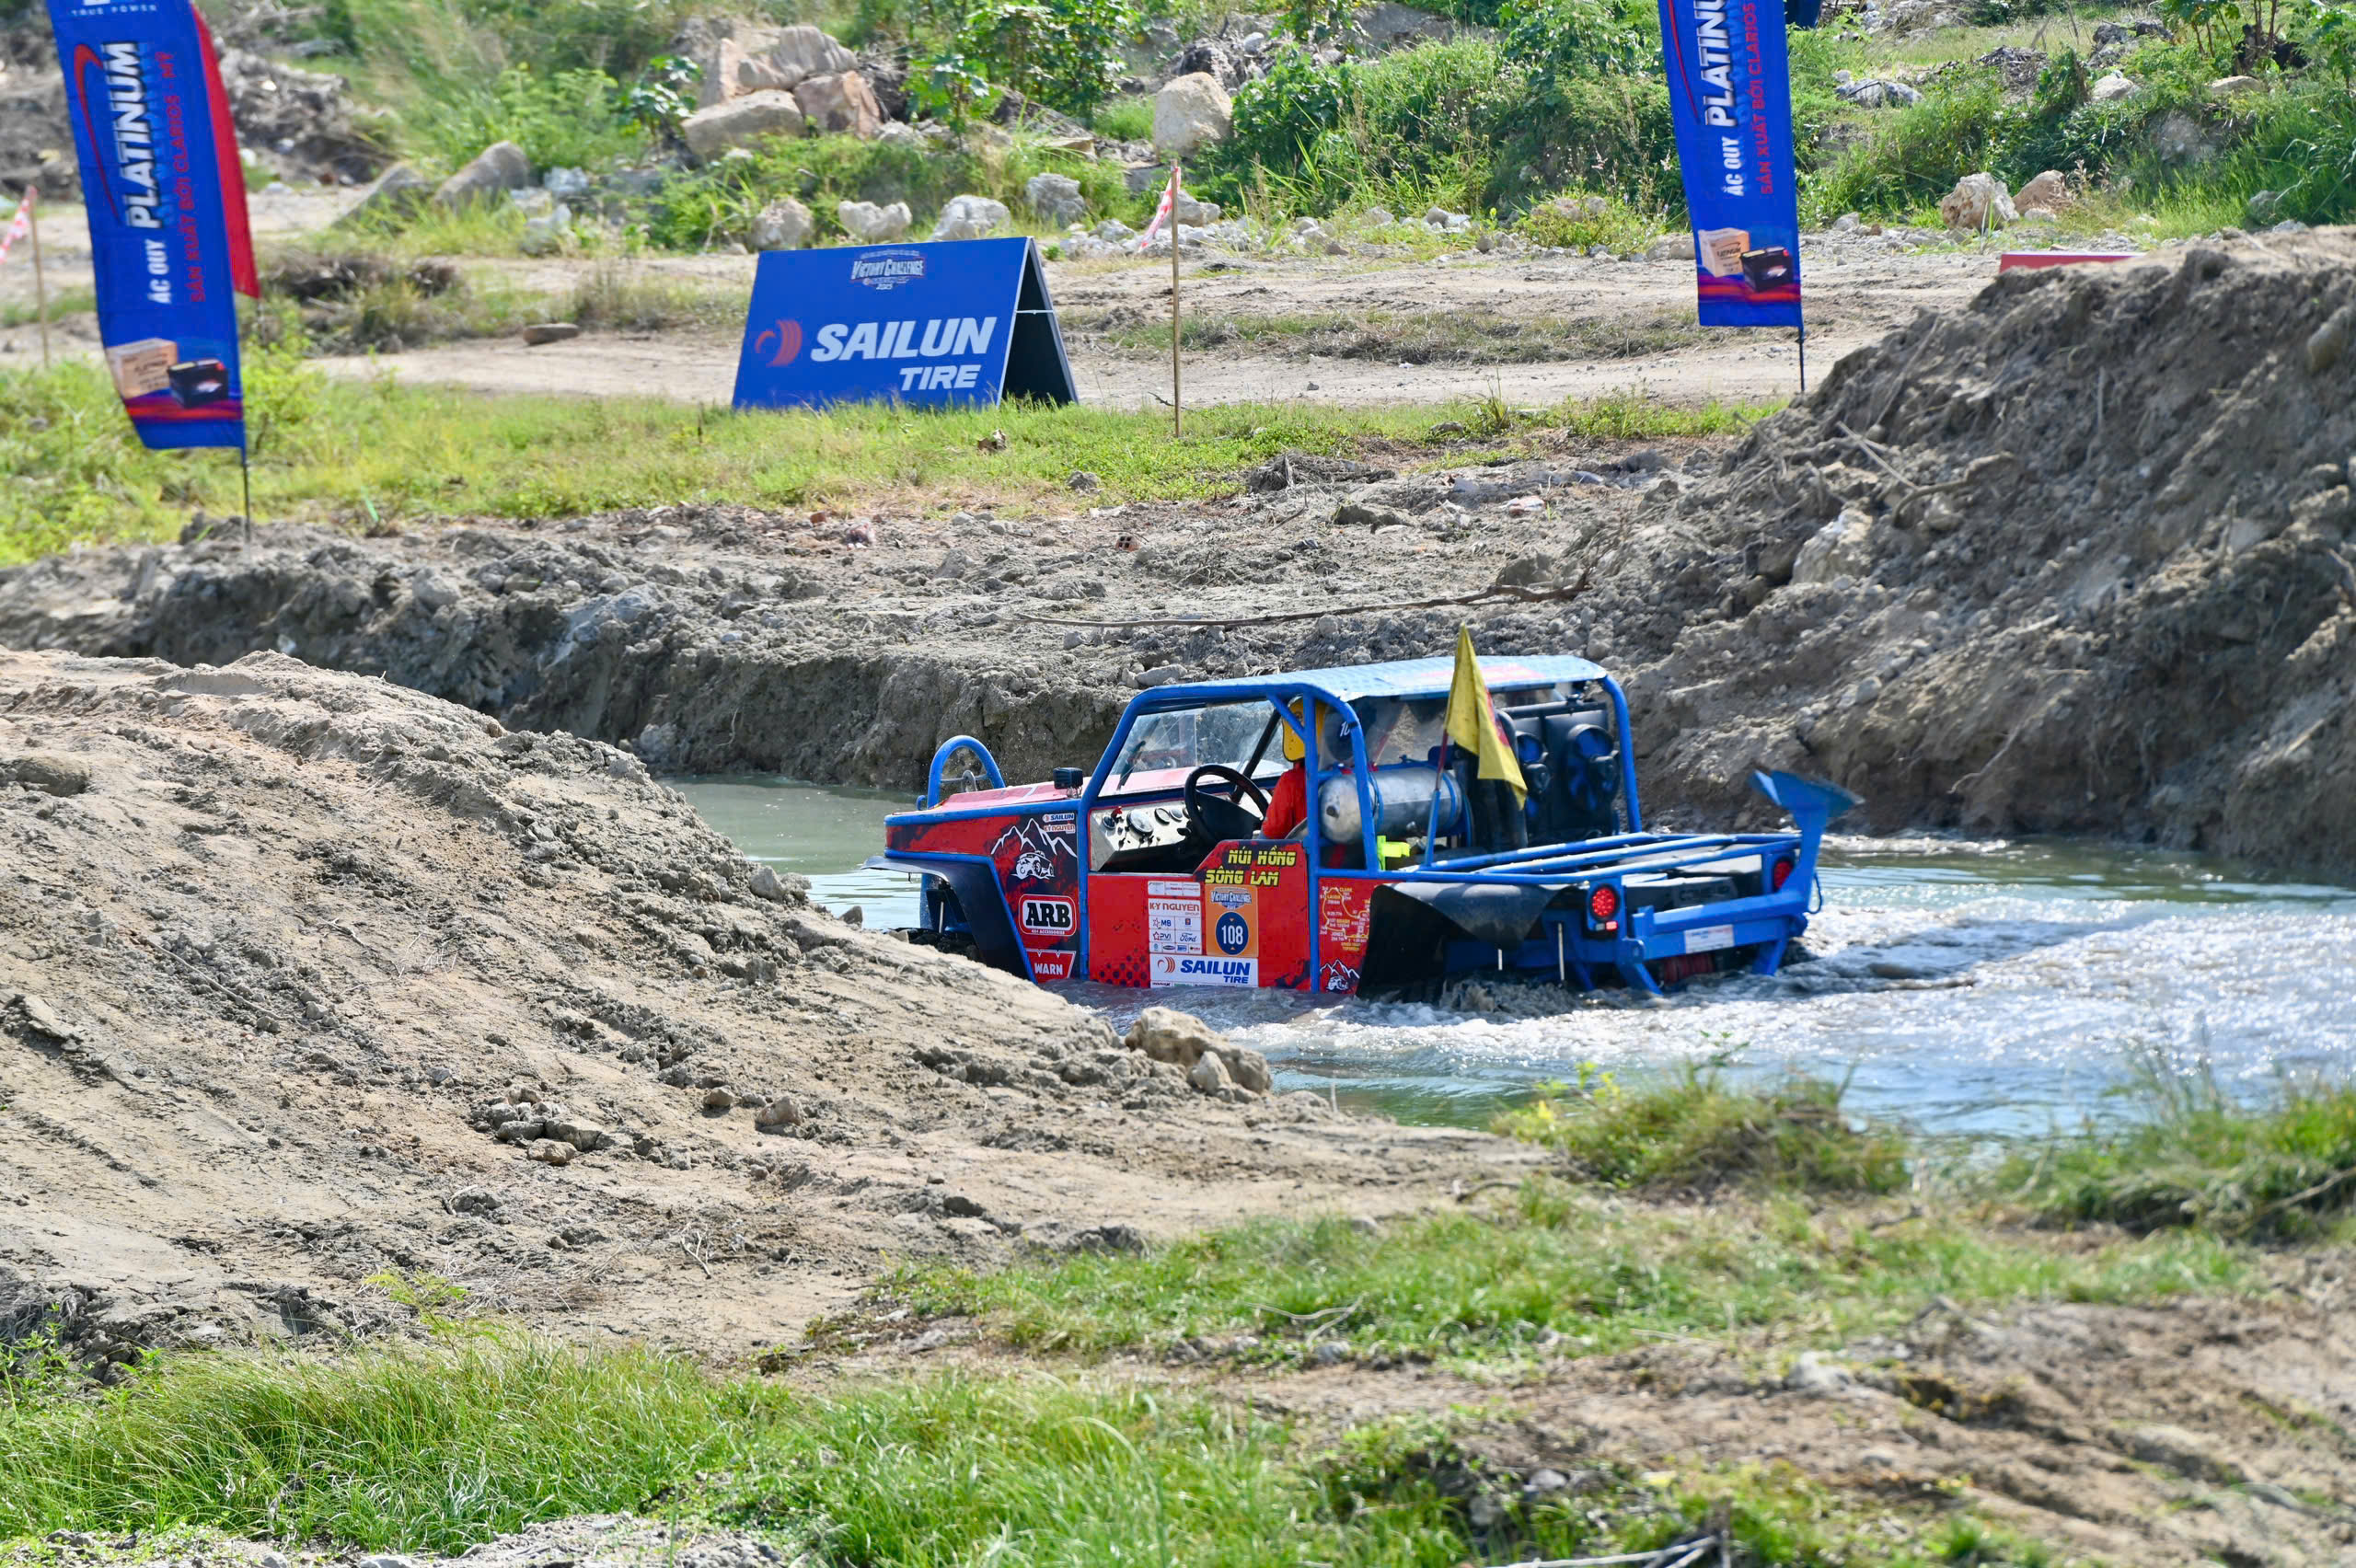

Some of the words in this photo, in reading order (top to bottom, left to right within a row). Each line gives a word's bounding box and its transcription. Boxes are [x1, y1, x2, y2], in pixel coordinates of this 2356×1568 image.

[1742, 3, 1761, 75] CLARIOS
[101, 41, 164, 229] PLATINUM
[165, 96, 190, 173] CLARIOS
[1721, 136, 1742, 170] QUY
[811, 317, 997, 362] SAILUN
[899, 364, 981, 391] TIRE
[1228, 847, 1252, 864] NÚI
[1205, 866, 1244, 884] SÔNG
[1251, 870, 1279, 886] LAM
[1026, 902, 1071, 928] ARB
[1179, 932, 1197, 942] Ford
[1222, 926, 1243, 945] 108
[1034, 963, 1064, 975] WARN
[1180, 959, 1251, 976] SAILUN
[1223, 975, 1249, 985] TIRE
